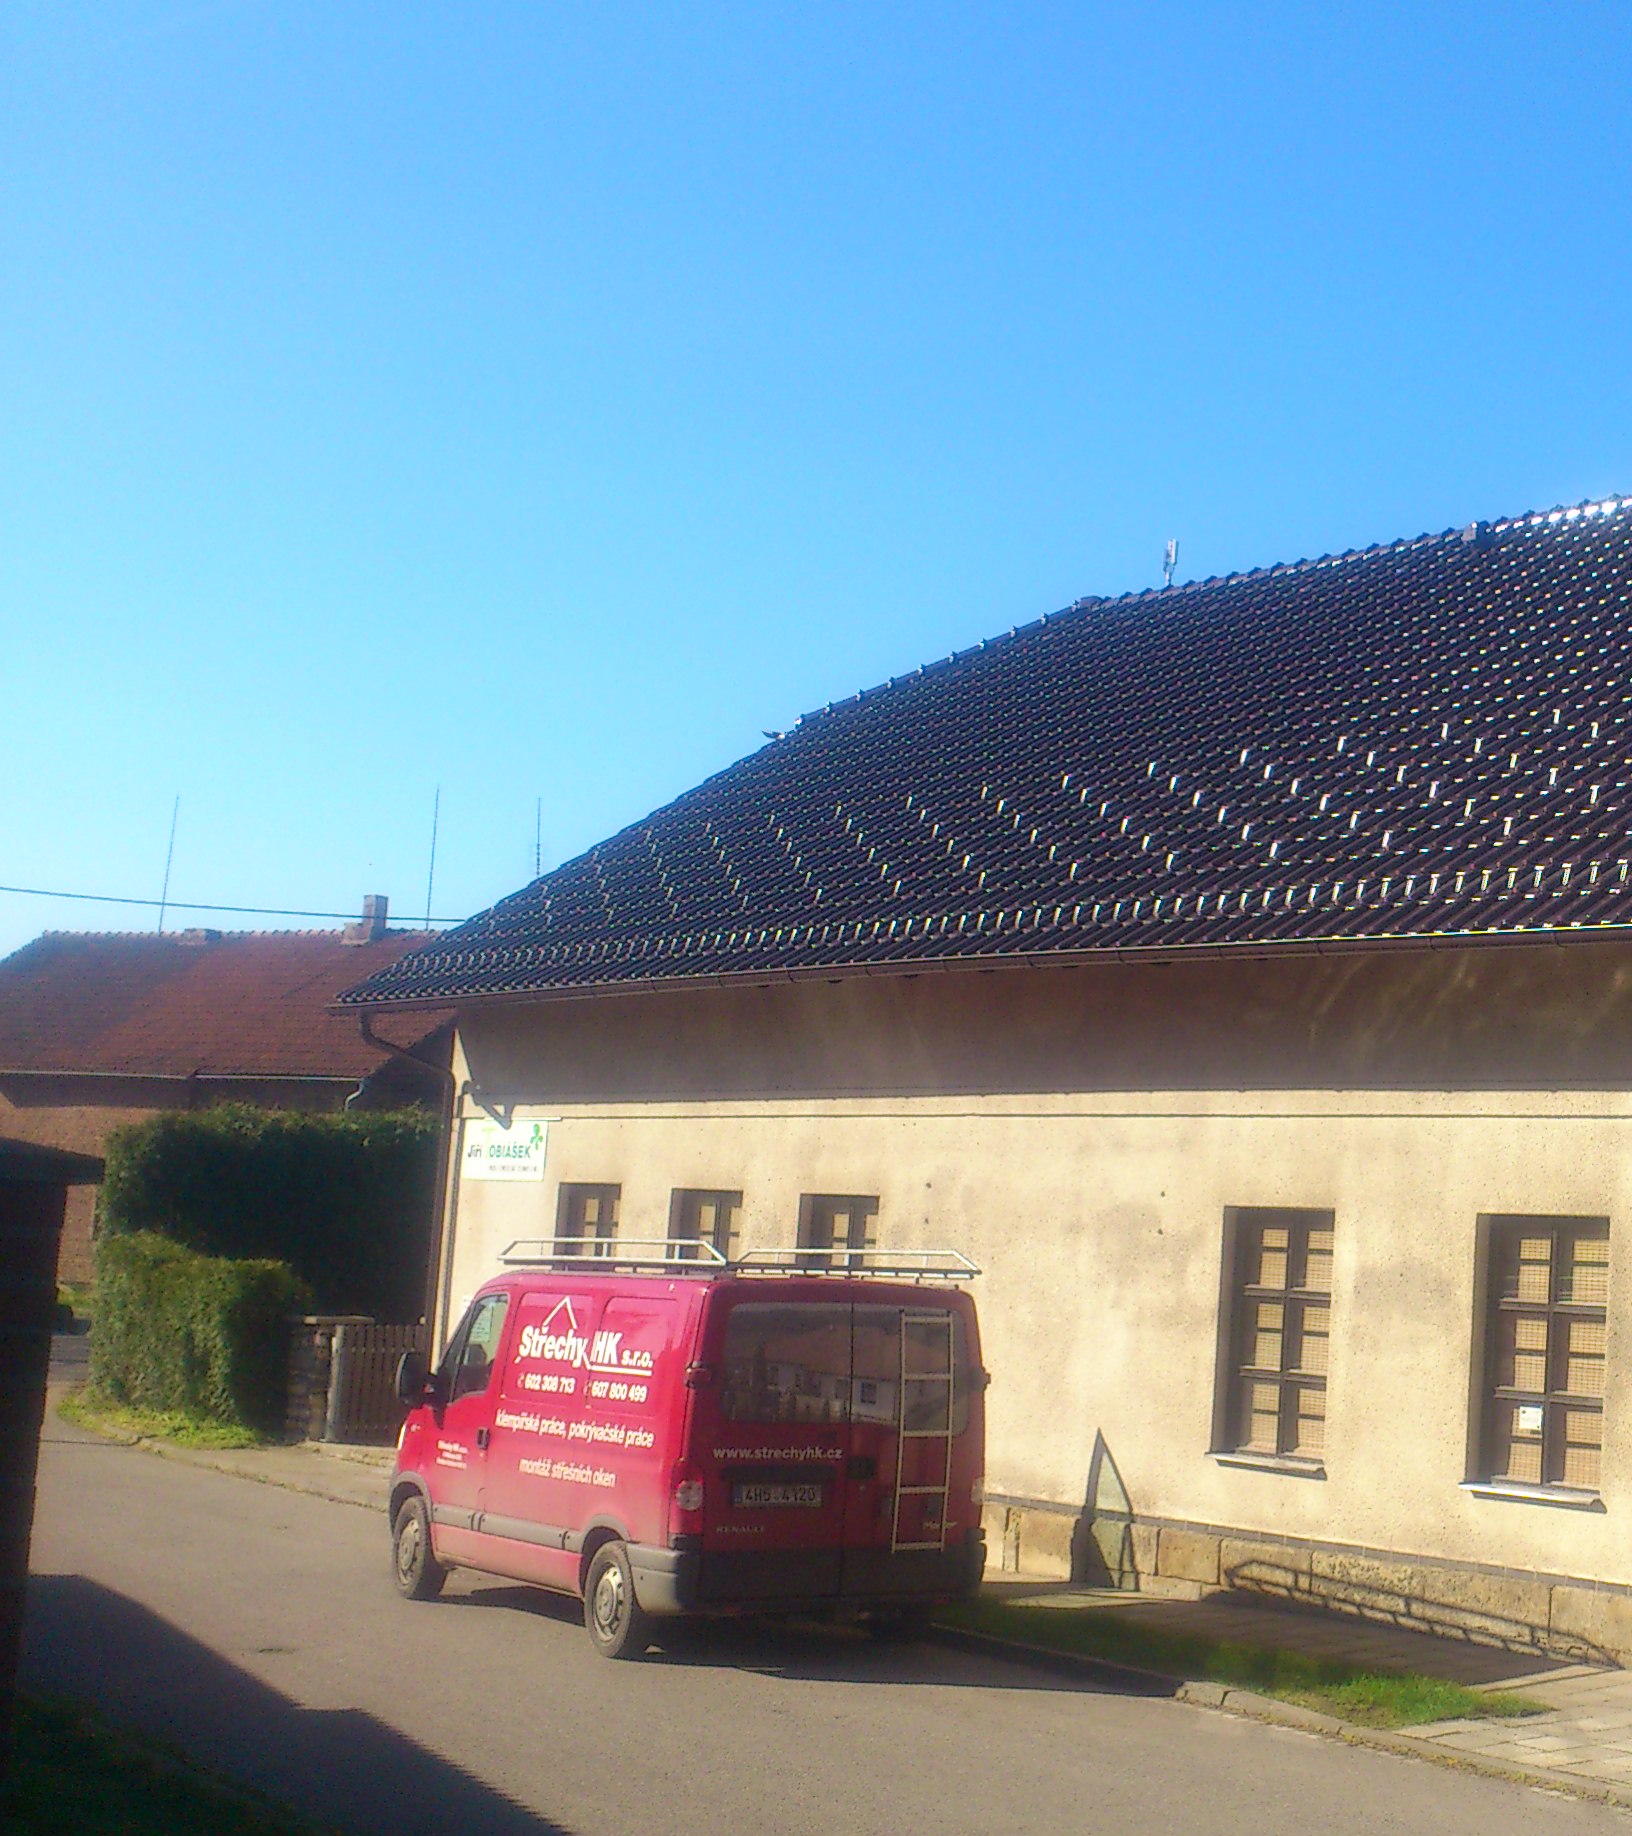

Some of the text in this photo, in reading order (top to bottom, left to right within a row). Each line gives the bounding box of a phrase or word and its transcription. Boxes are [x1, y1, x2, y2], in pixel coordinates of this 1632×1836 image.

[519, 1325, 589, 1368] Střechy
[590, 1331, 623, 1365] HK
[621, 1349, 654, 1369] s.r.o.
[524, 1373, 542, 1390] 602
[559, 1377, 576, 1394] 713
[591, 1380, 648, 1403] 607 800 499
[625, 1427, 655, 1448] práce
[713, 1446, 843, 1460] www.strechyhk.cz
[518, 1457, 552, 1478] montáž
[592, 1467, 617, 1488] oken
